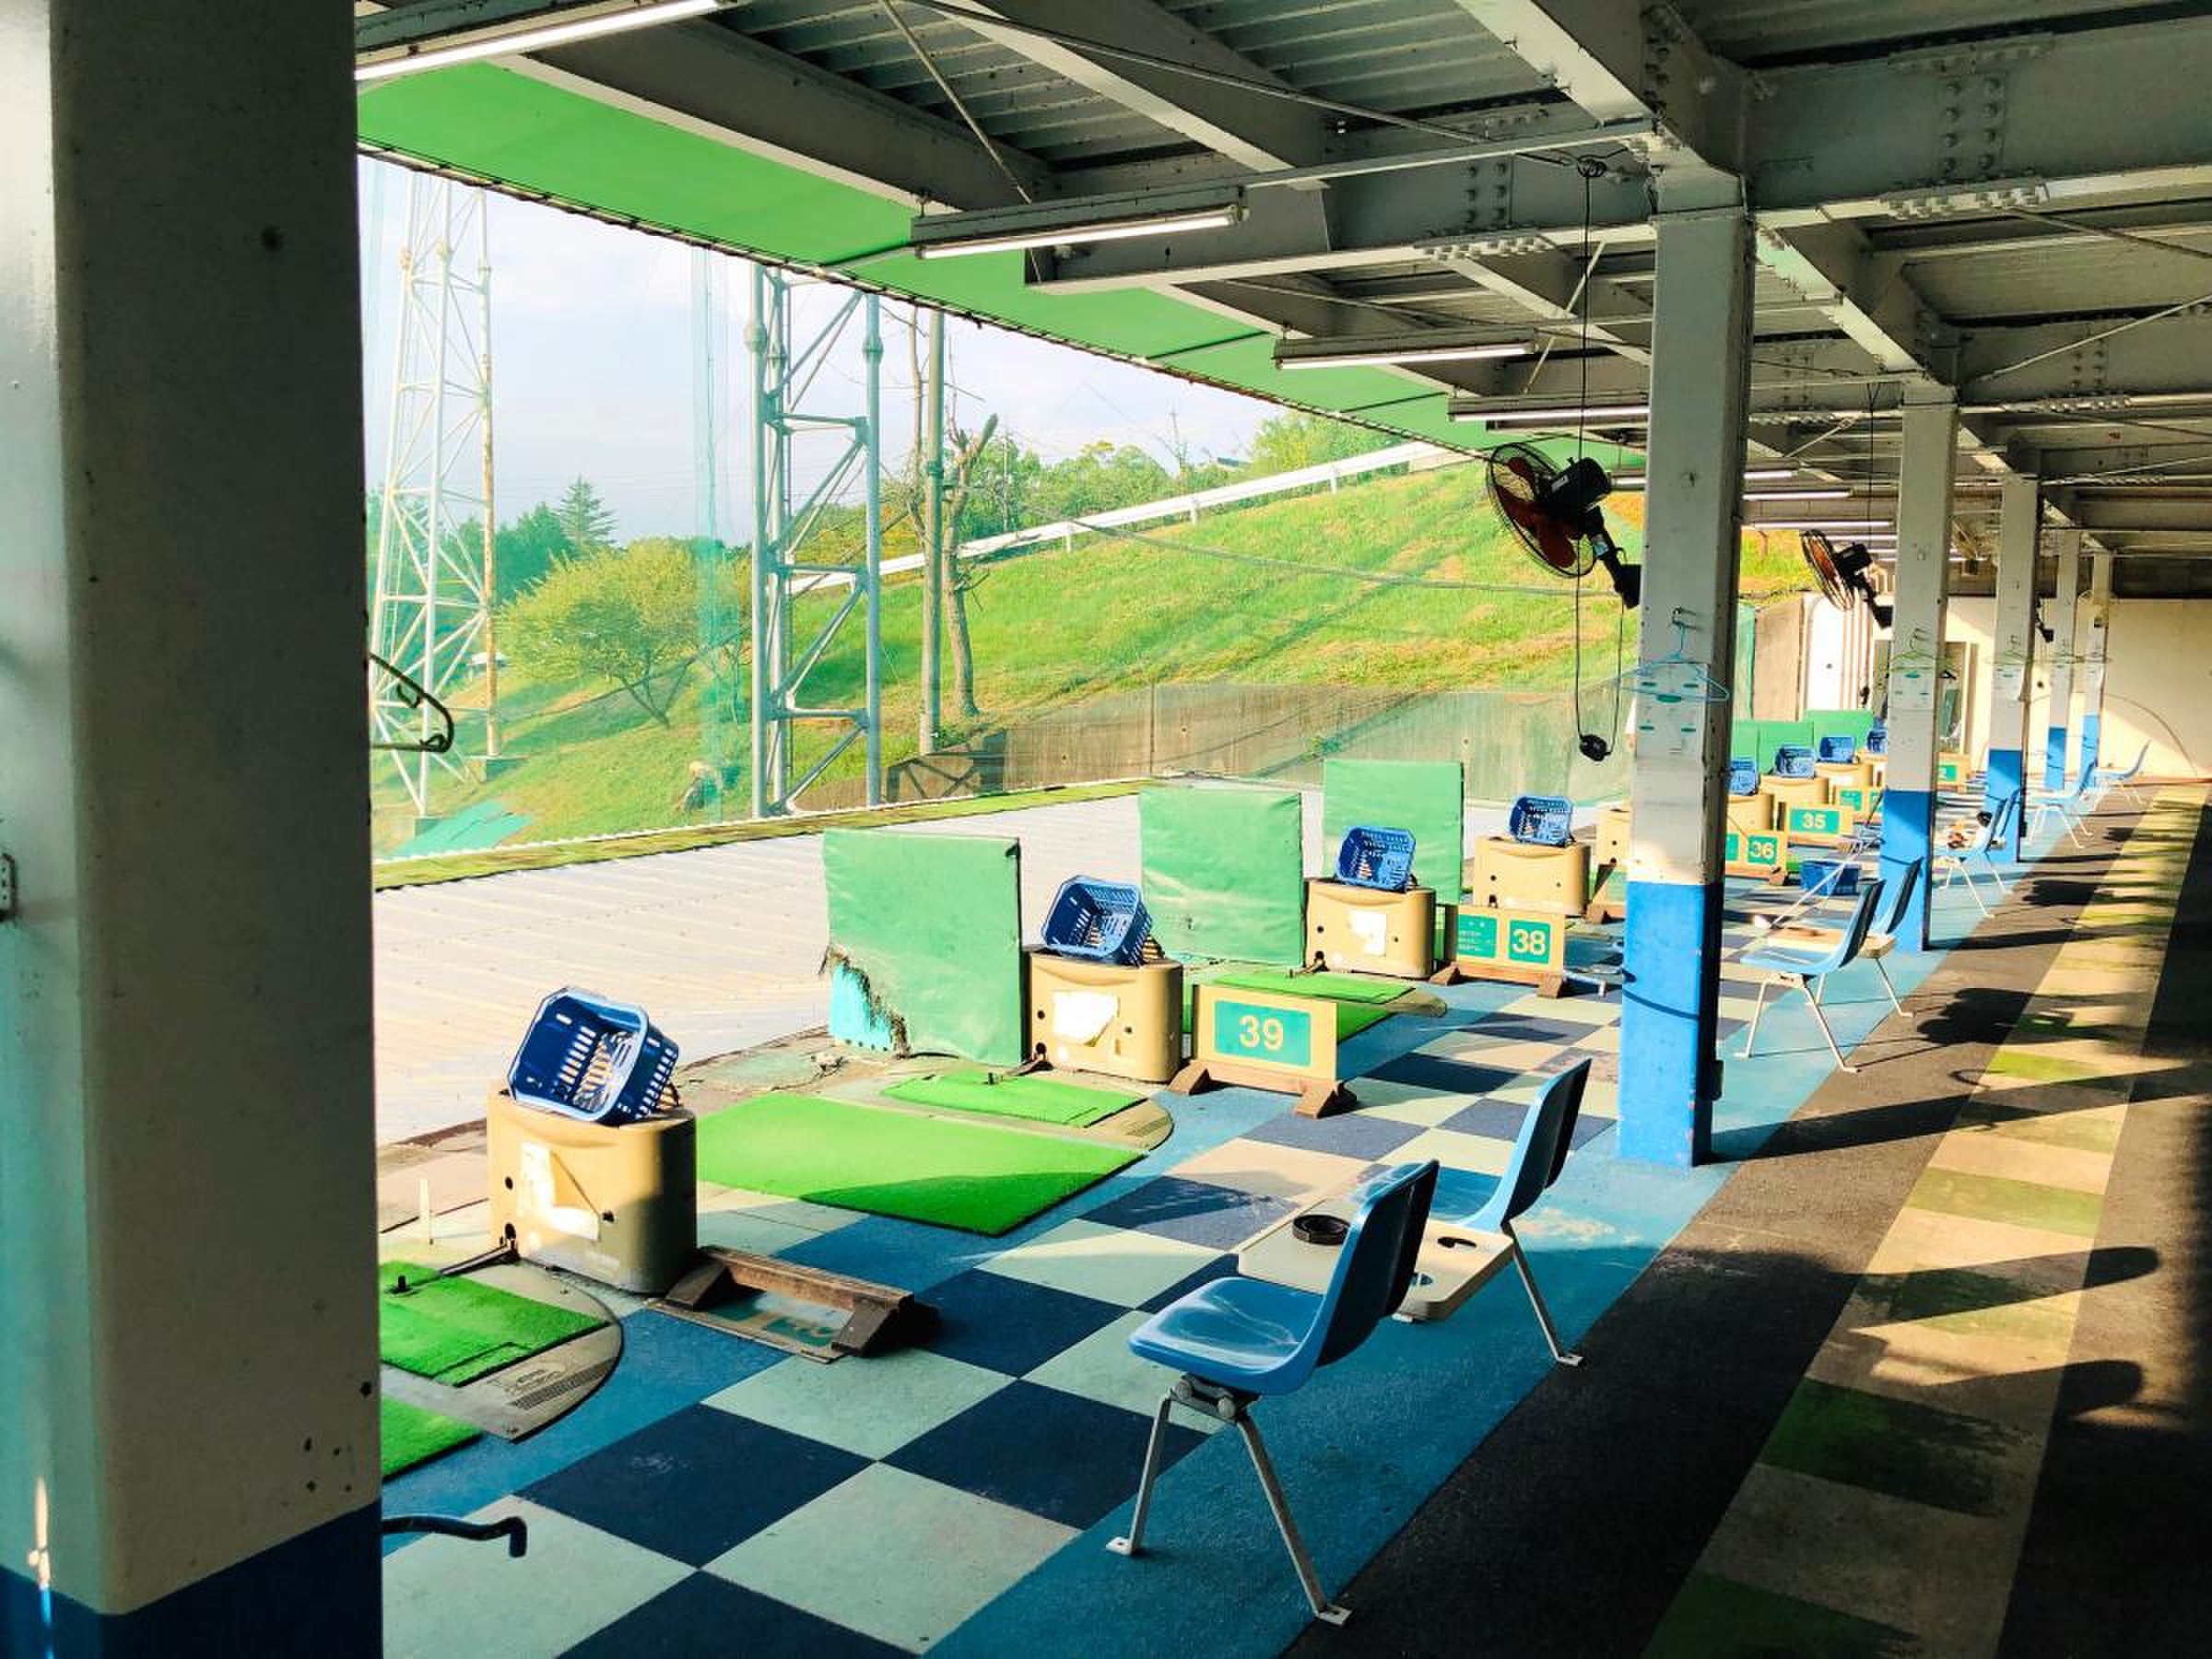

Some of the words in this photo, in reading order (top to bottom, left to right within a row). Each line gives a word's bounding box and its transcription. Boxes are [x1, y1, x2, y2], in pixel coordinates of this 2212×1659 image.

[1802, 813, 1826, 829] 35
[1751, 841, 1774, 858] 36
[1512, 929, 1546, 955] 38
[1239, 1015, 1284, 1051] 39
